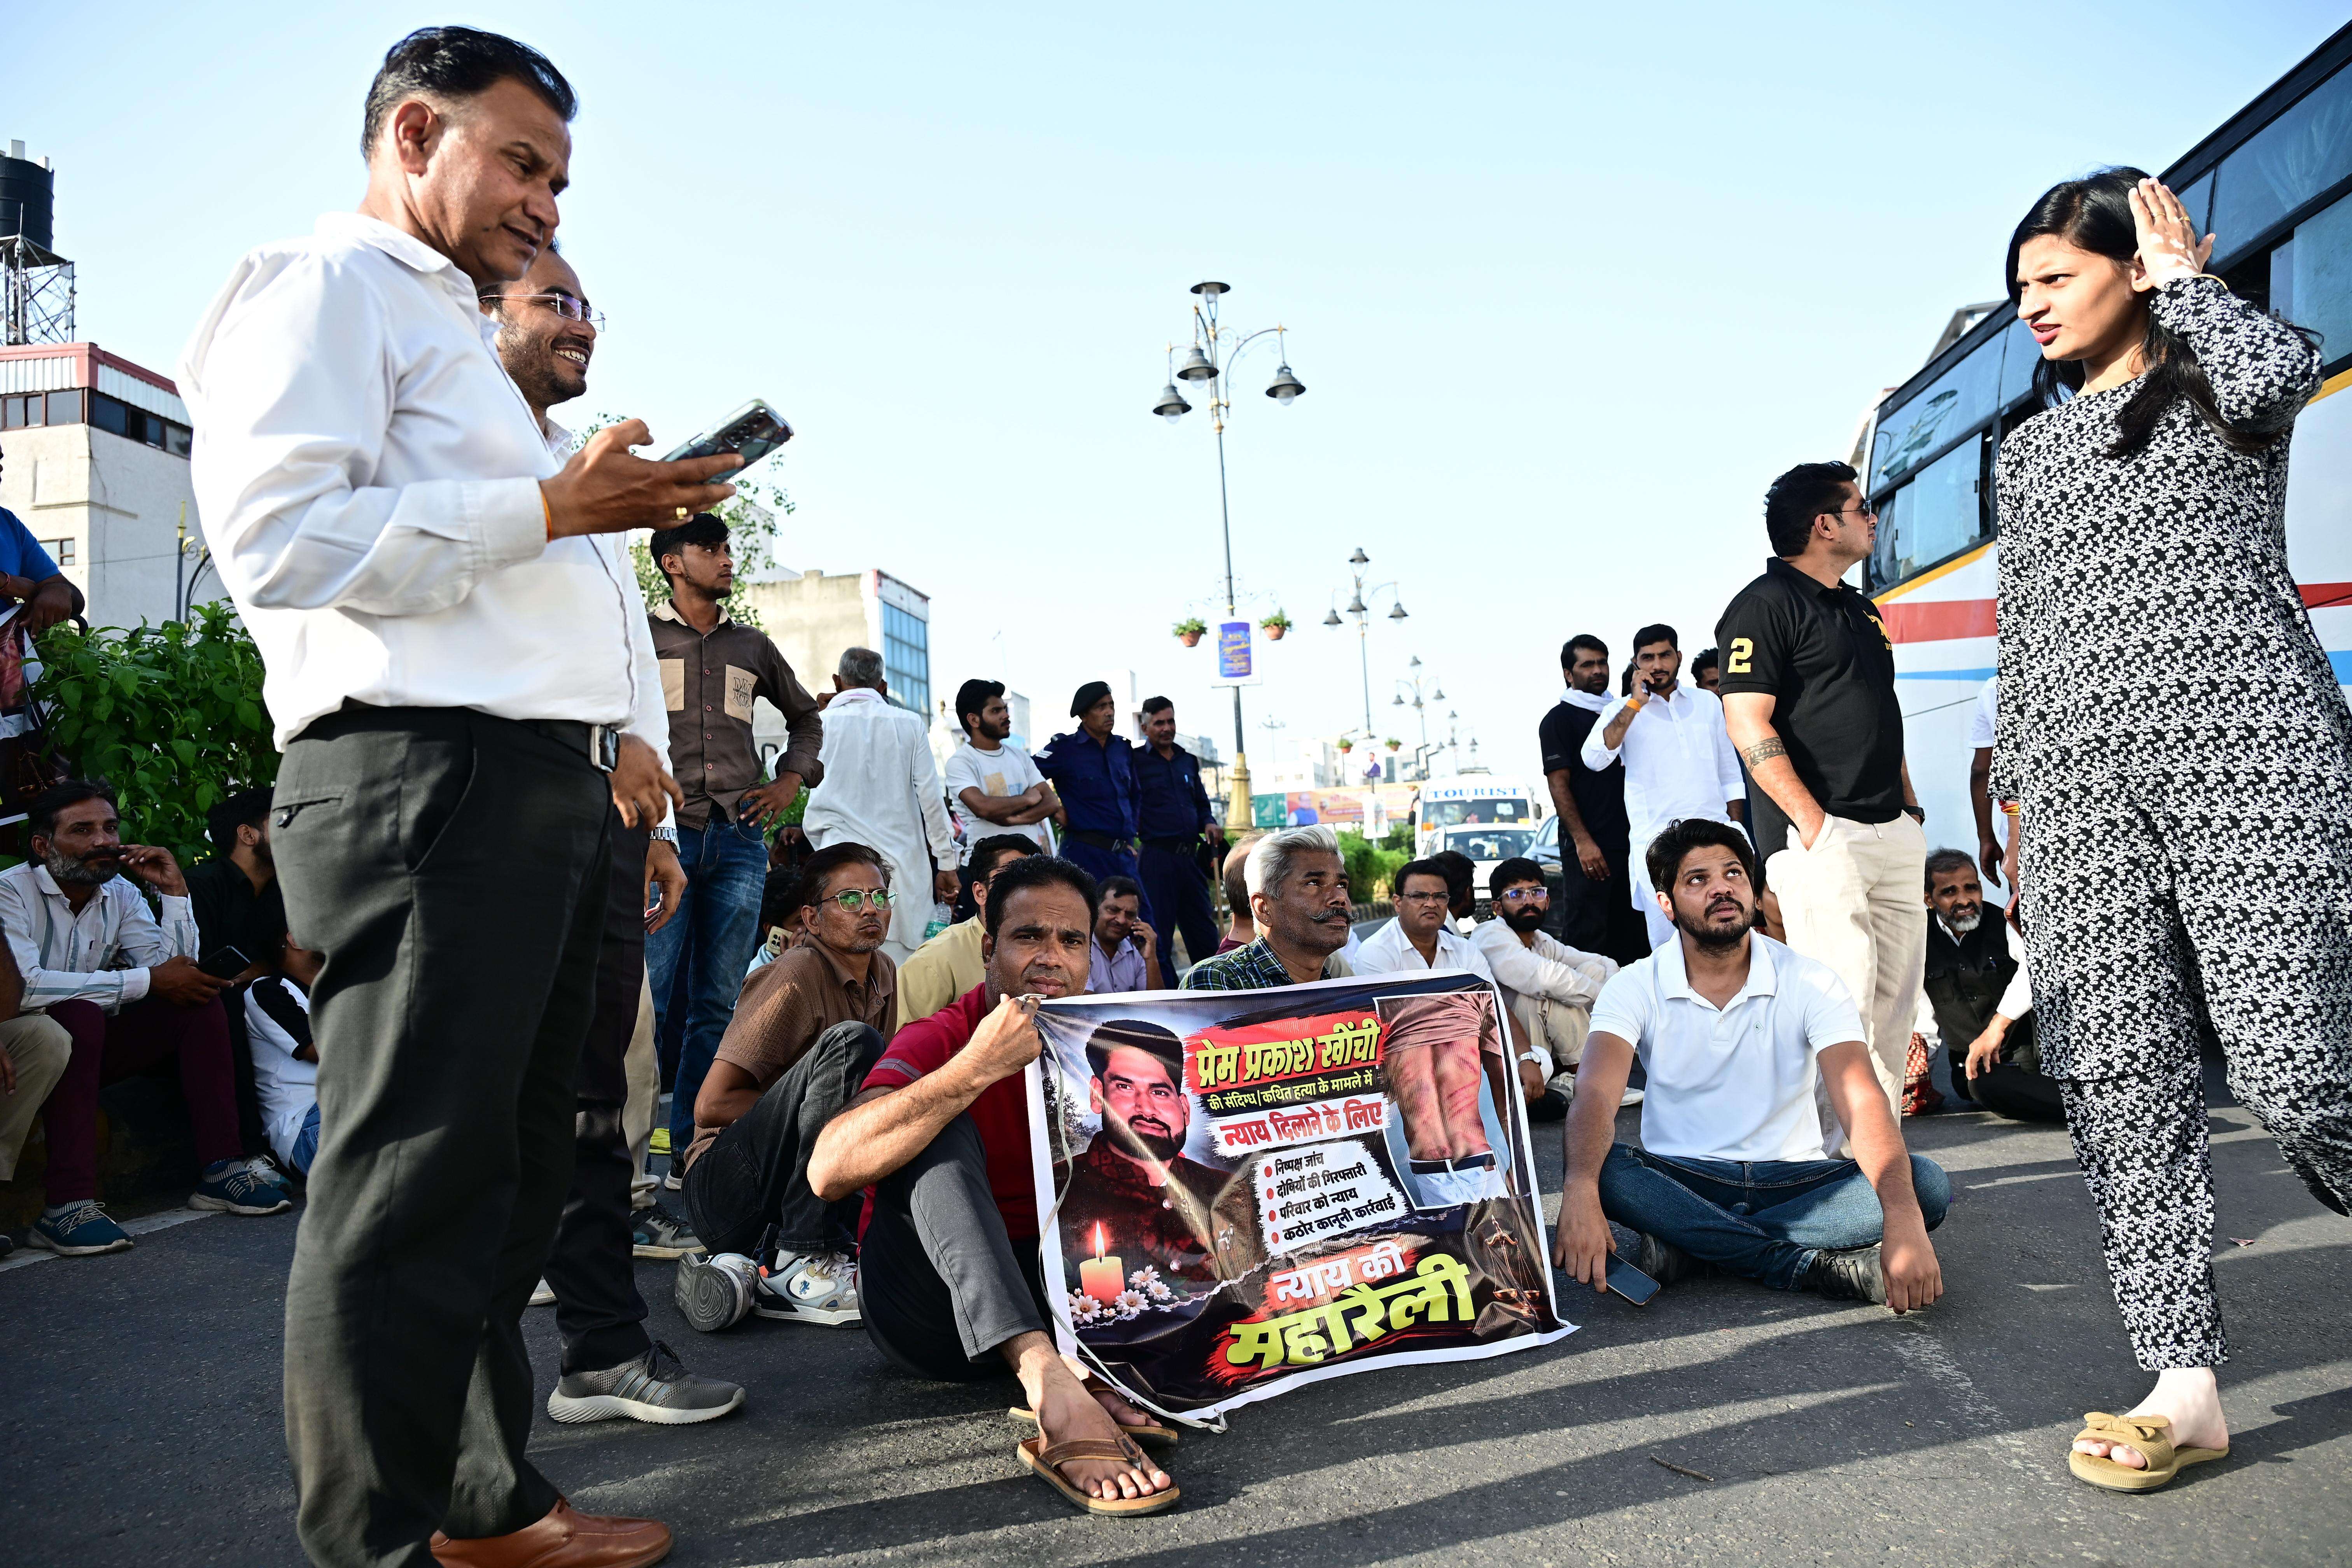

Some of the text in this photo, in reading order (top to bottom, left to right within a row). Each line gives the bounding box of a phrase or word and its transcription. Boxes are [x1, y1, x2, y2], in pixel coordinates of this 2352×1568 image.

[1727, 637, 1753, 673] 2
[1430, 788, 1520, 798] TOURIST
[1196, 1018, 1382, 1087] प्रेम प्रकाश खींची
[1208, 1092, 1223, 1111] की
[1294, 1082, 1316, 1100] हत्या
[1317, 1079, 1329, 1093] के
[1332, 1071, 1362, 1090] मामले
[1363, 1069, 1373, 1087] में
[1219, 1099, 1383, 1146] न्याय दिलाने के लिए
[1274, 1151, 1325, 1176] निष्पक्ष जांच
[1276, 1162, 1368, 1198] दोषियों की गिरफ्तारी
[1279, 1187, 1359, 1220] परिवार को न्याय
[1283, 1193, 1396, 1241] कठोर कानूनी कार्रवाई
[1272, 1241, 1408, 1302] न्याय की
[1226, 1253, 1476, 1370] महारैली
